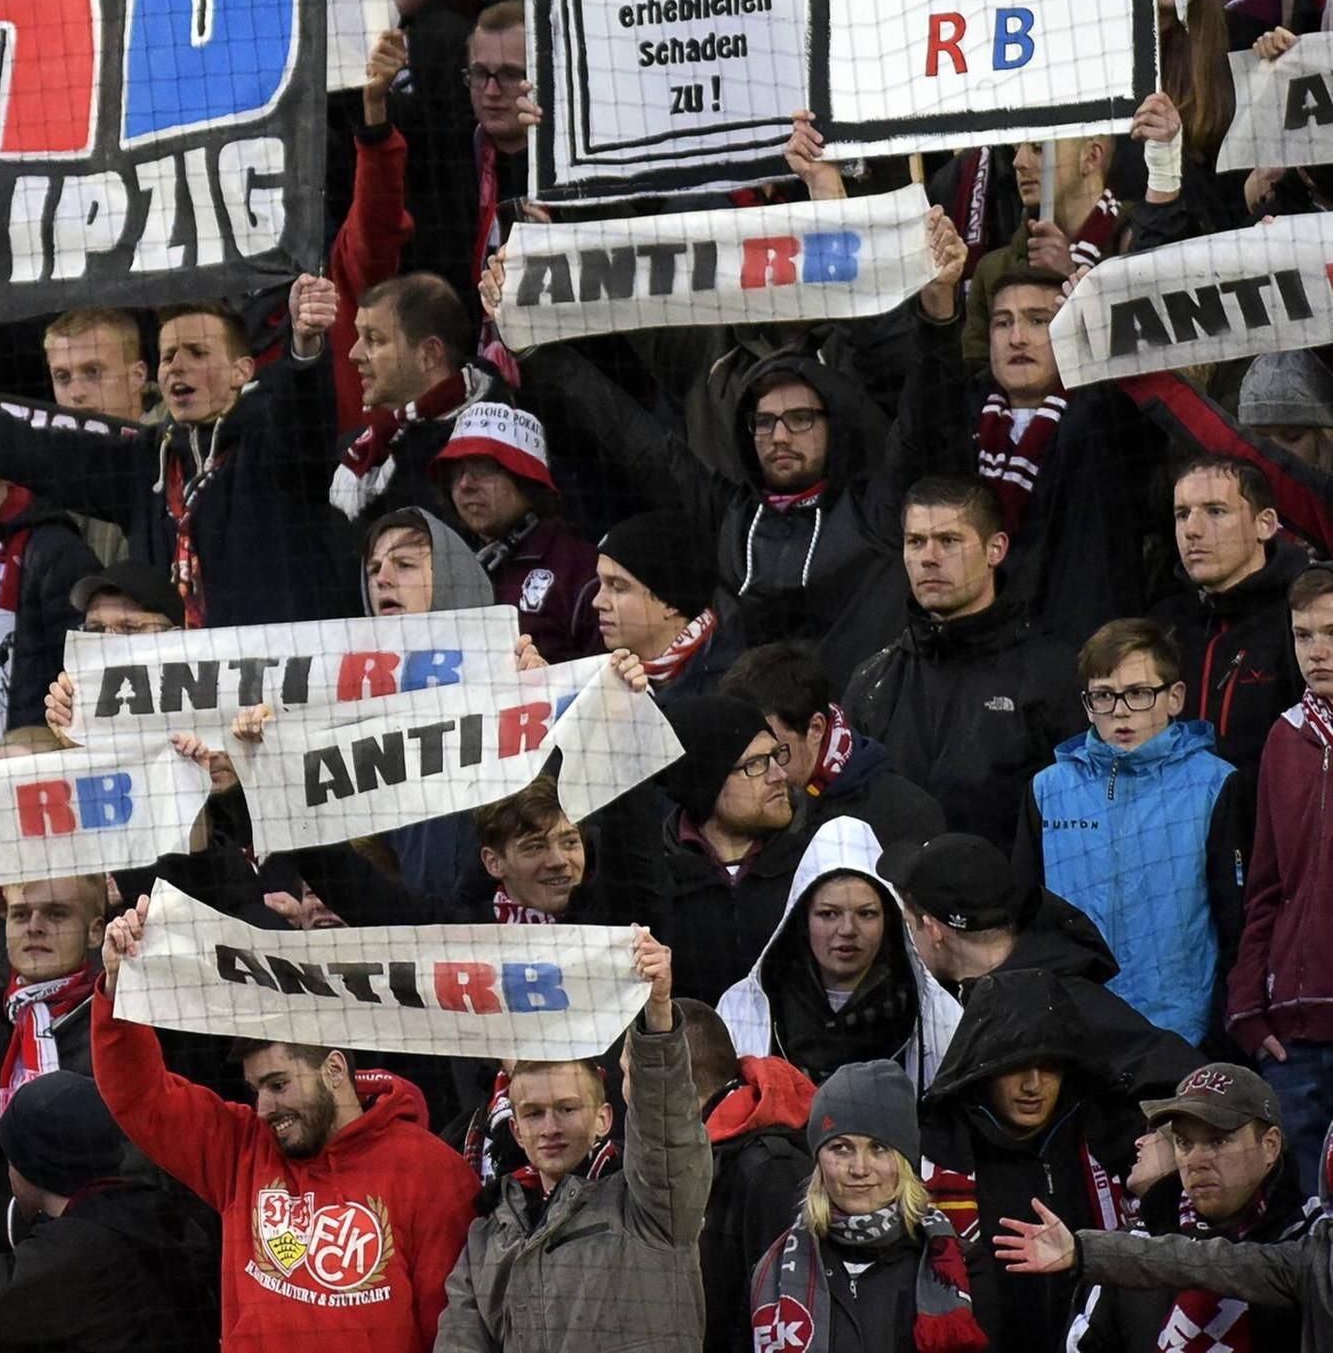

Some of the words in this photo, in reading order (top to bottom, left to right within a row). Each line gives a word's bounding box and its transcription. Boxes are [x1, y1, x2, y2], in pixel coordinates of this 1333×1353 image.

[638, 30, 749, 68] schaden
[517, 241, 717, 307] ANTI
[740, 231, 861, 289] RB
[1110, 269, 1314, 357] ANTI
[94, 655, 312, 718] ANTI
[336, 648, 463, 703] RB
[303, 713, 484, 809] ANTI
[15, 771, 135, 838] RB
[1042, 820, 1100, 830] BURTON
[214, 943, 427, 1008] ANTI
[433, 960, 571, 1016] RB
[317, 1294, 327, 1307] &
[327, 1285, 392, 1308] STUTTGART
